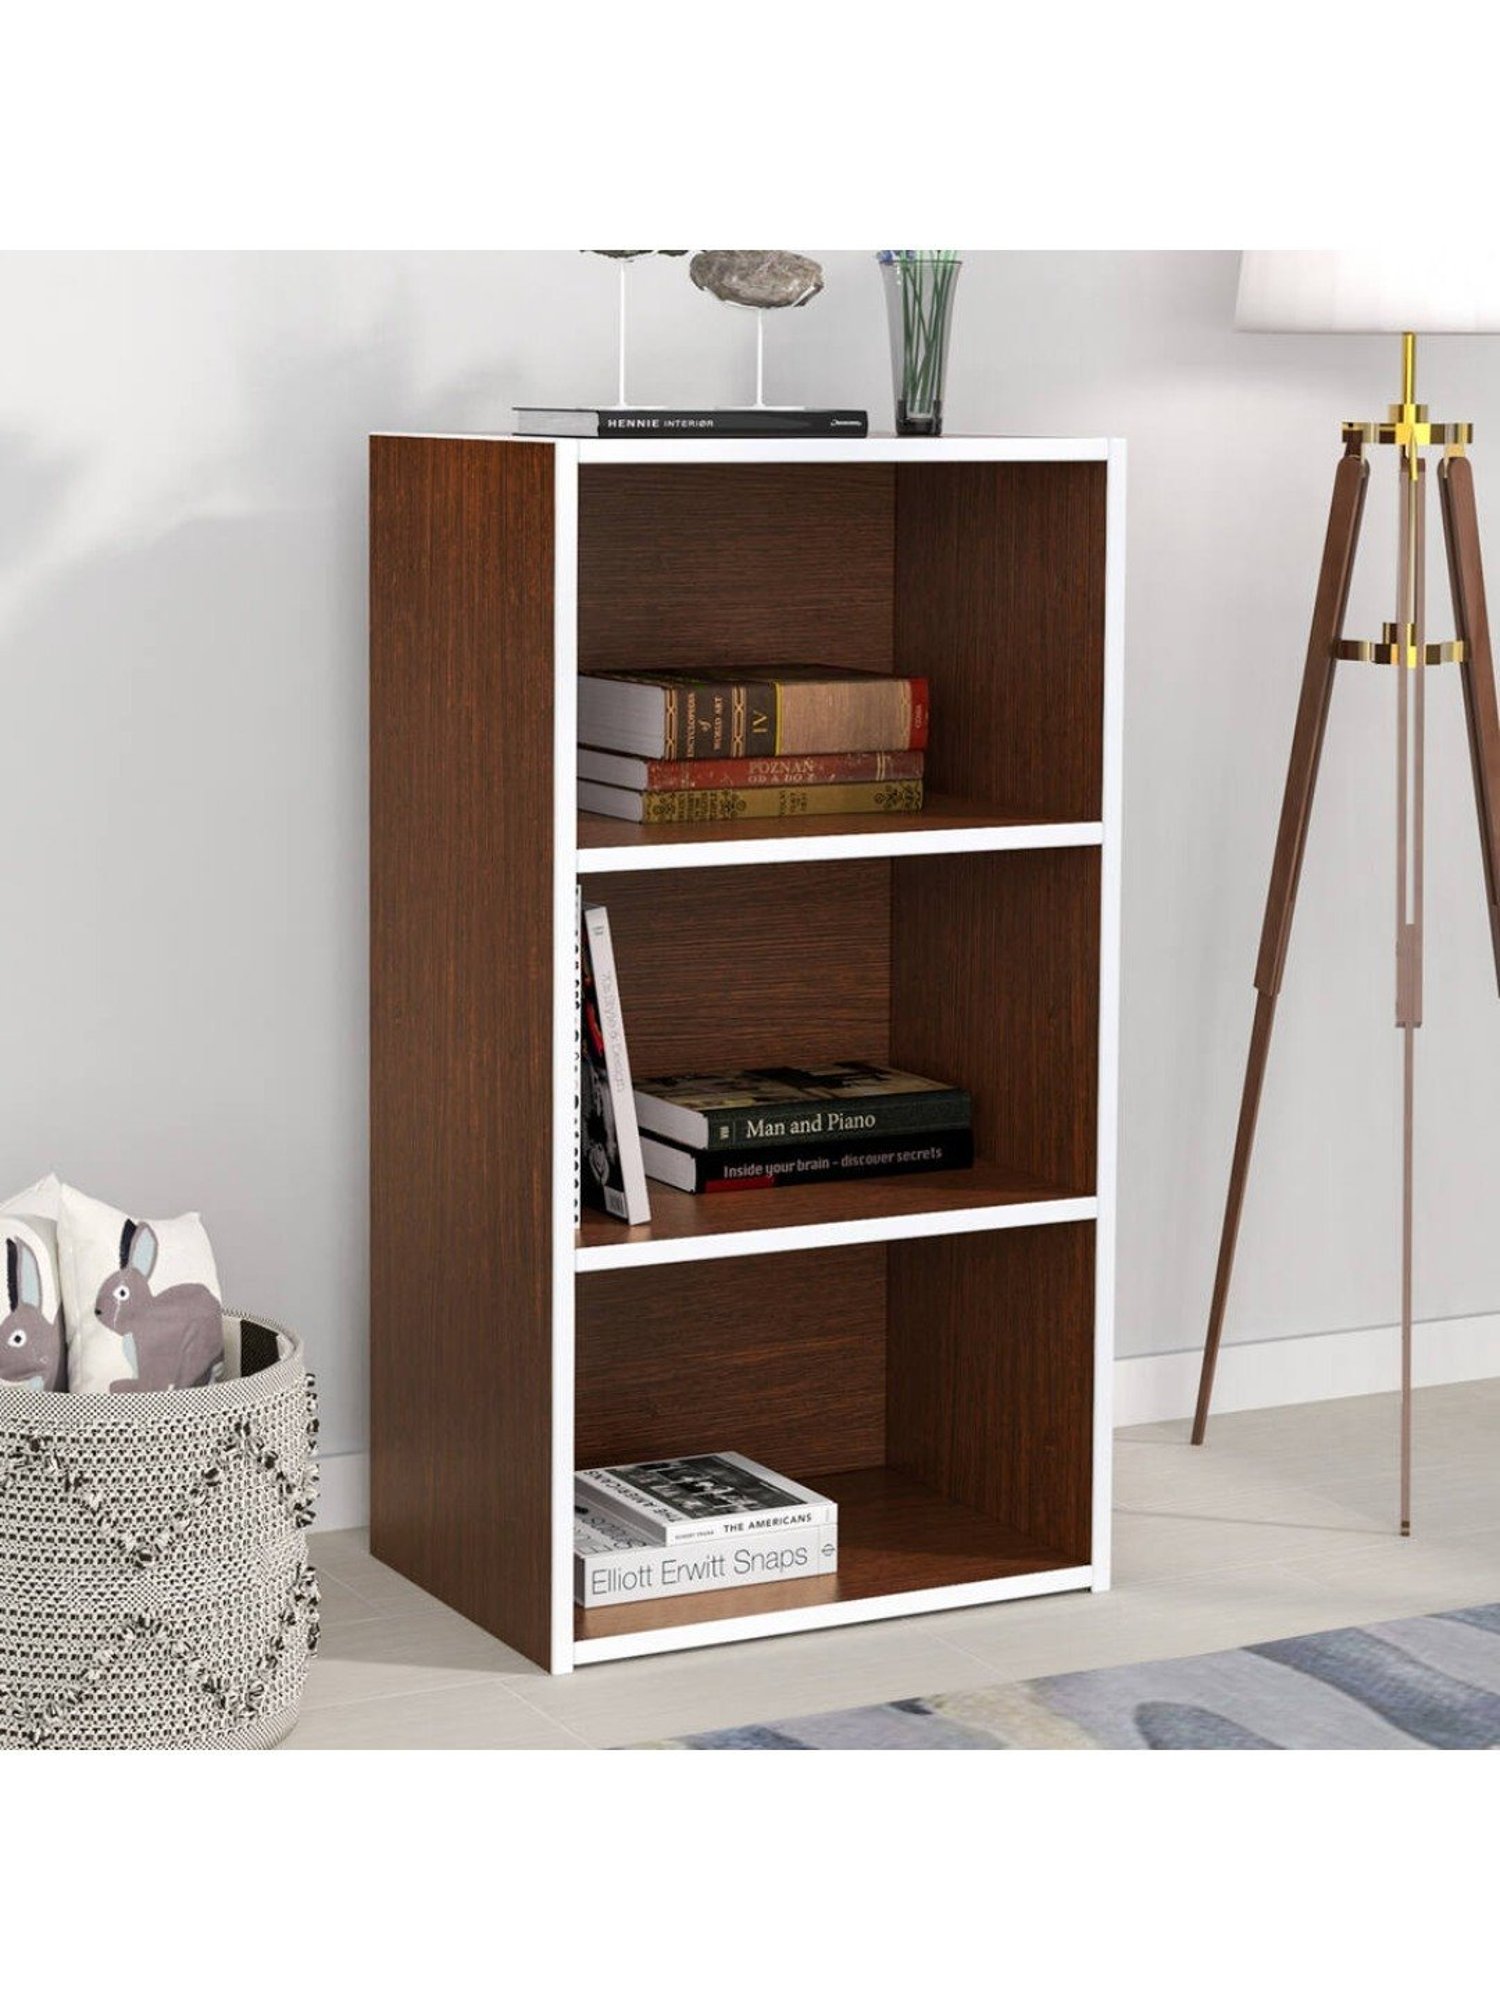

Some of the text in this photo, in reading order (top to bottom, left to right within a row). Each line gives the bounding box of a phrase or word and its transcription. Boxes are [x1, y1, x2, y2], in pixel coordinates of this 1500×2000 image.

[607, 419, 660, 429] HENNIE
[714, 696, 723, 715] ART
[752, 710, 768, 733] IV
[746, 1119, 785, 1138] Man
[790, 1113, 823, 1134] and
[828, 1113, 876, 1132] Piano
[723, 1164, 762, 1179] Inside
[766, 1162, 795, 1177] your
[797, 1157, 830, 1172] brain
[841, 1152, 894, 1168] discover
[897, 1147, 942, 1163] secrets
[723, 1521, 744, 1533] THE
[748, 1513, 812, 1531] AMERICANS
[591, 1546, 808, 1595] Elliott Erwitt Snaps
